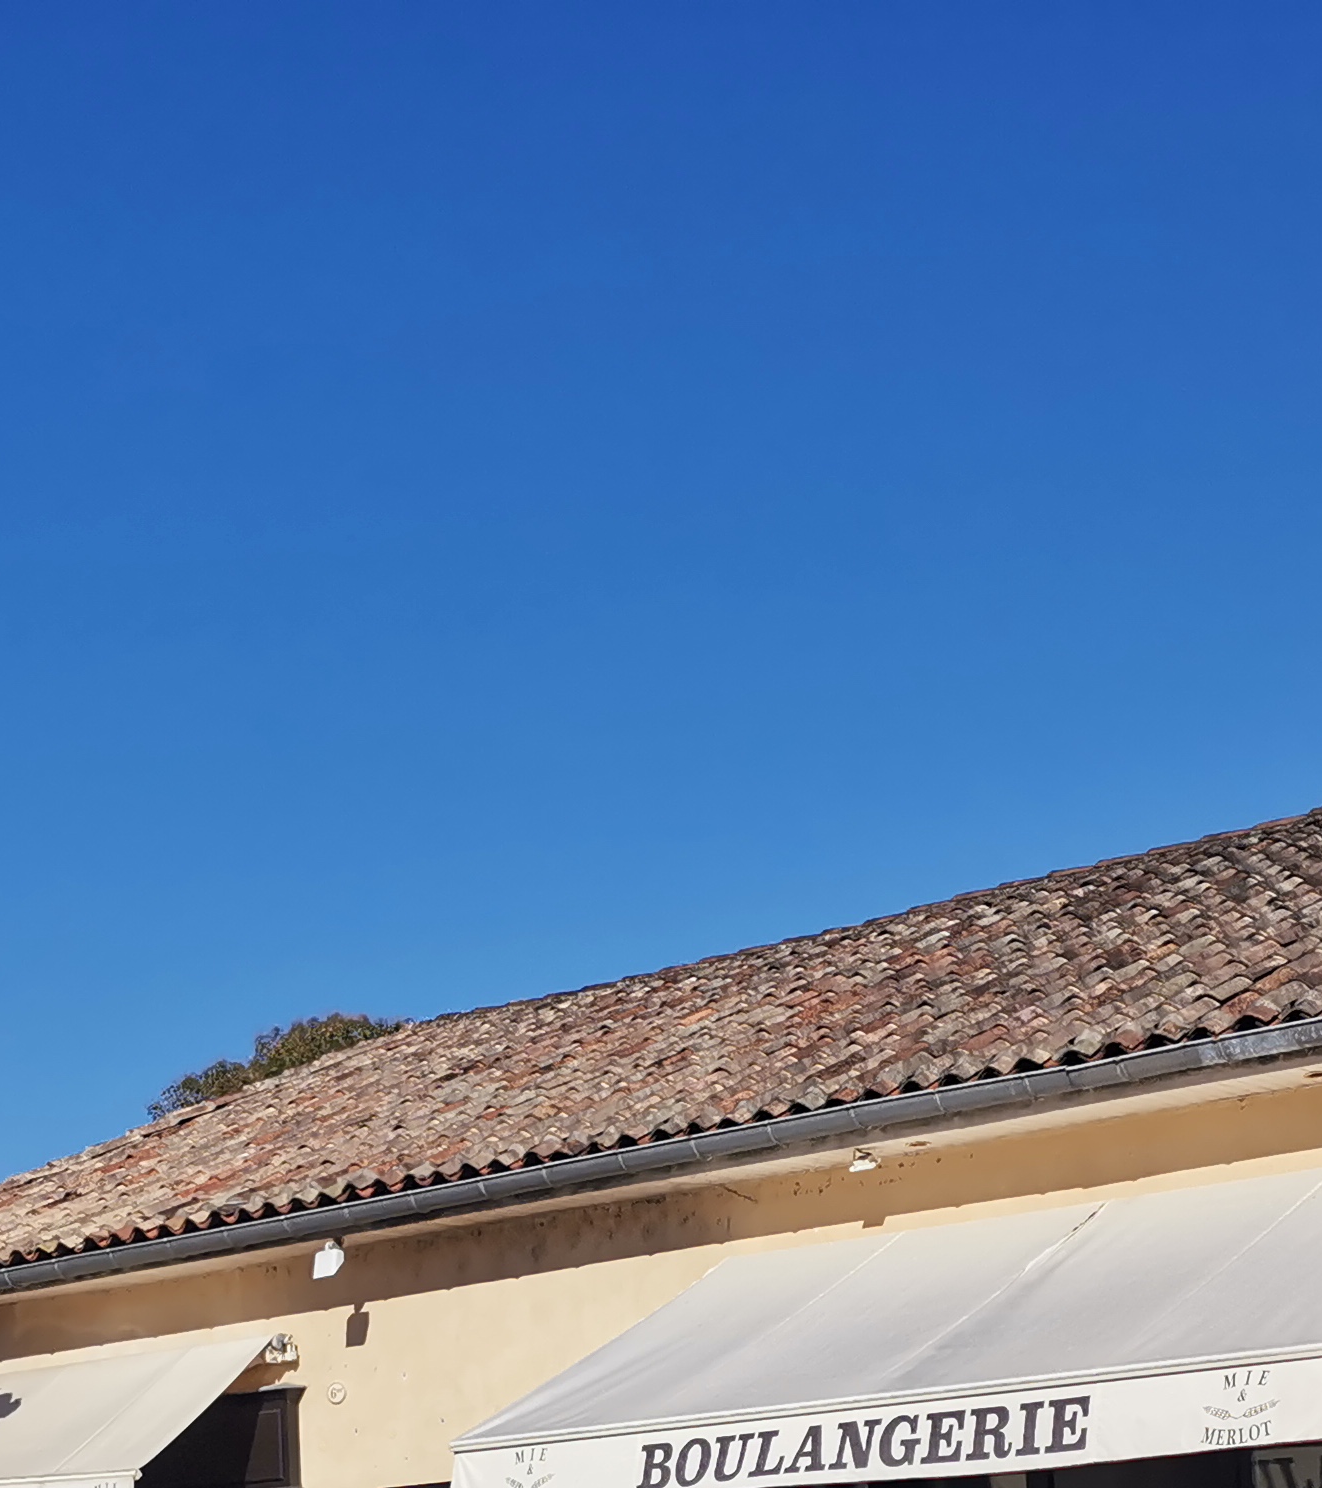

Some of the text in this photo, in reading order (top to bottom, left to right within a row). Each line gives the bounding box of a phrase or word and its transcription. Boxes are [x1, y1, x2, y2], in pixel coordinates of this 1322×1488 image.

[1223, 1370, 1270, 1390] MIE
[1201, 1420, 1272, 1445] MERLOT
[515, 1448, 548, 1465] MIE
